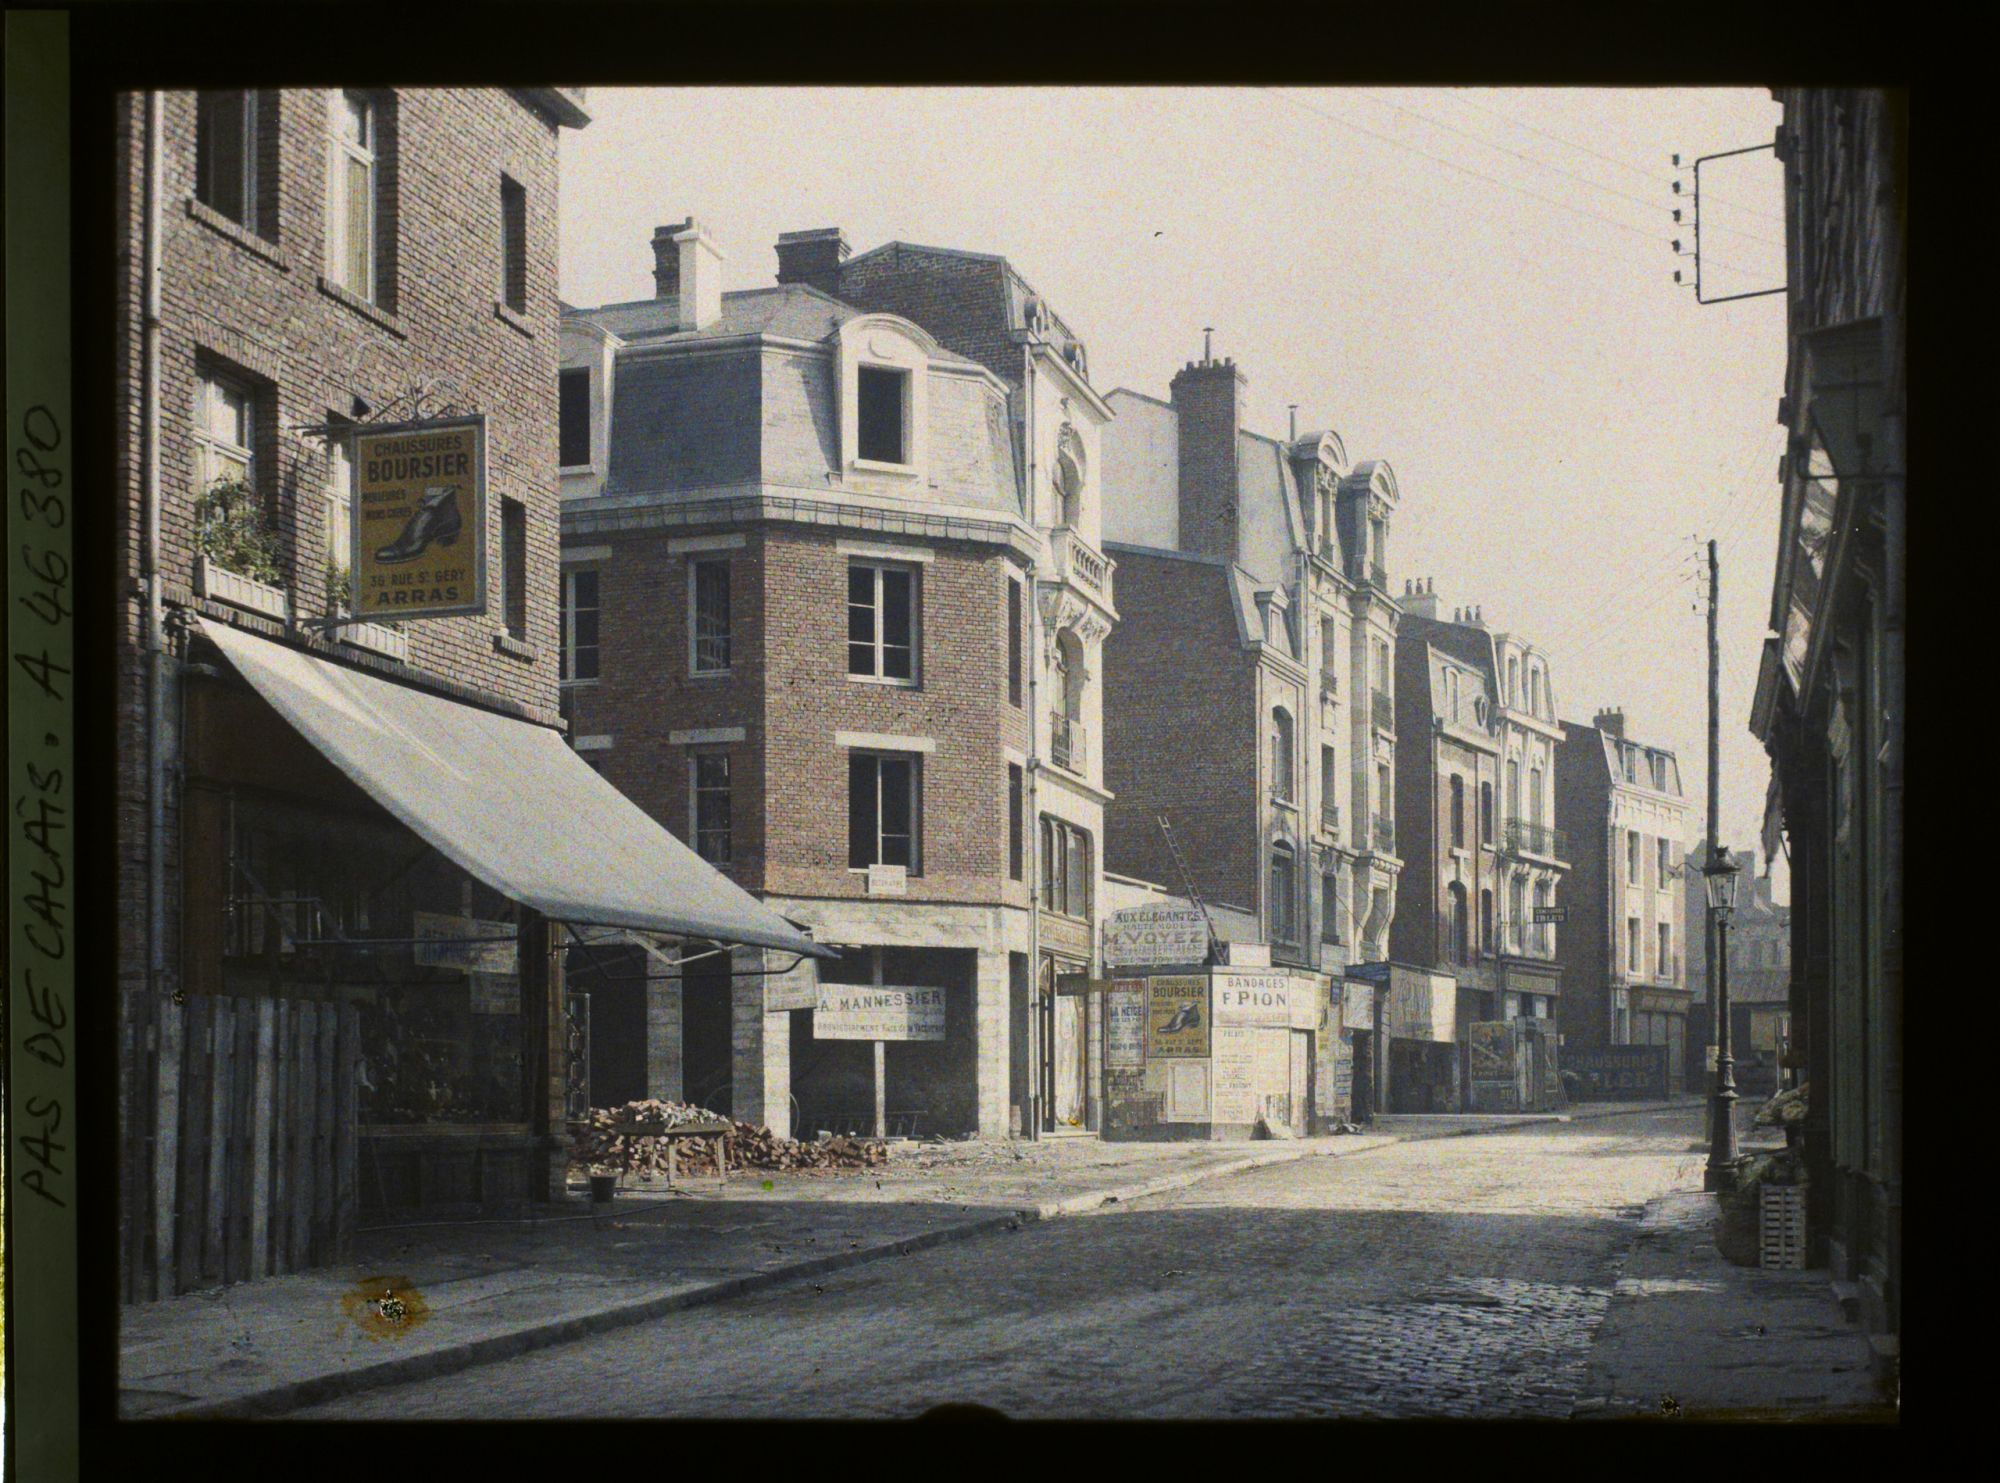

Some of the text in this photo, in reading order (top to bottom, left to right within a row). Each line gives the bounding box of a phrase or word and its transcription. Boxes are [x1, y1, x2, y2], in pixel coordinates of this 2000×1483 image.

[374, 436, 462, 457] CHAUSSURES
[367, 453, 469, 483] BOURSIER
[391, 572, 413, 586] RUE
[435, 568, 466, 583] GERY
[377, 586, 460, 605] ARRAS
[18, 652, 62, 699] A
[1115, 911, 1201, 923] AUX ELEGANTES
[1124, 930, 1203, 944] VOYEZ
[1153, 986, 1204, 998] BOURSIER
[1227, 977, 1285, 989] BANDAGES
[839, 990, 942, 1010] MANNESSIER
[1237, 990, 1286, 1006] PION
[21, 970, 64, 1067] DE
[21, 1095, 64, 1206] PAS
